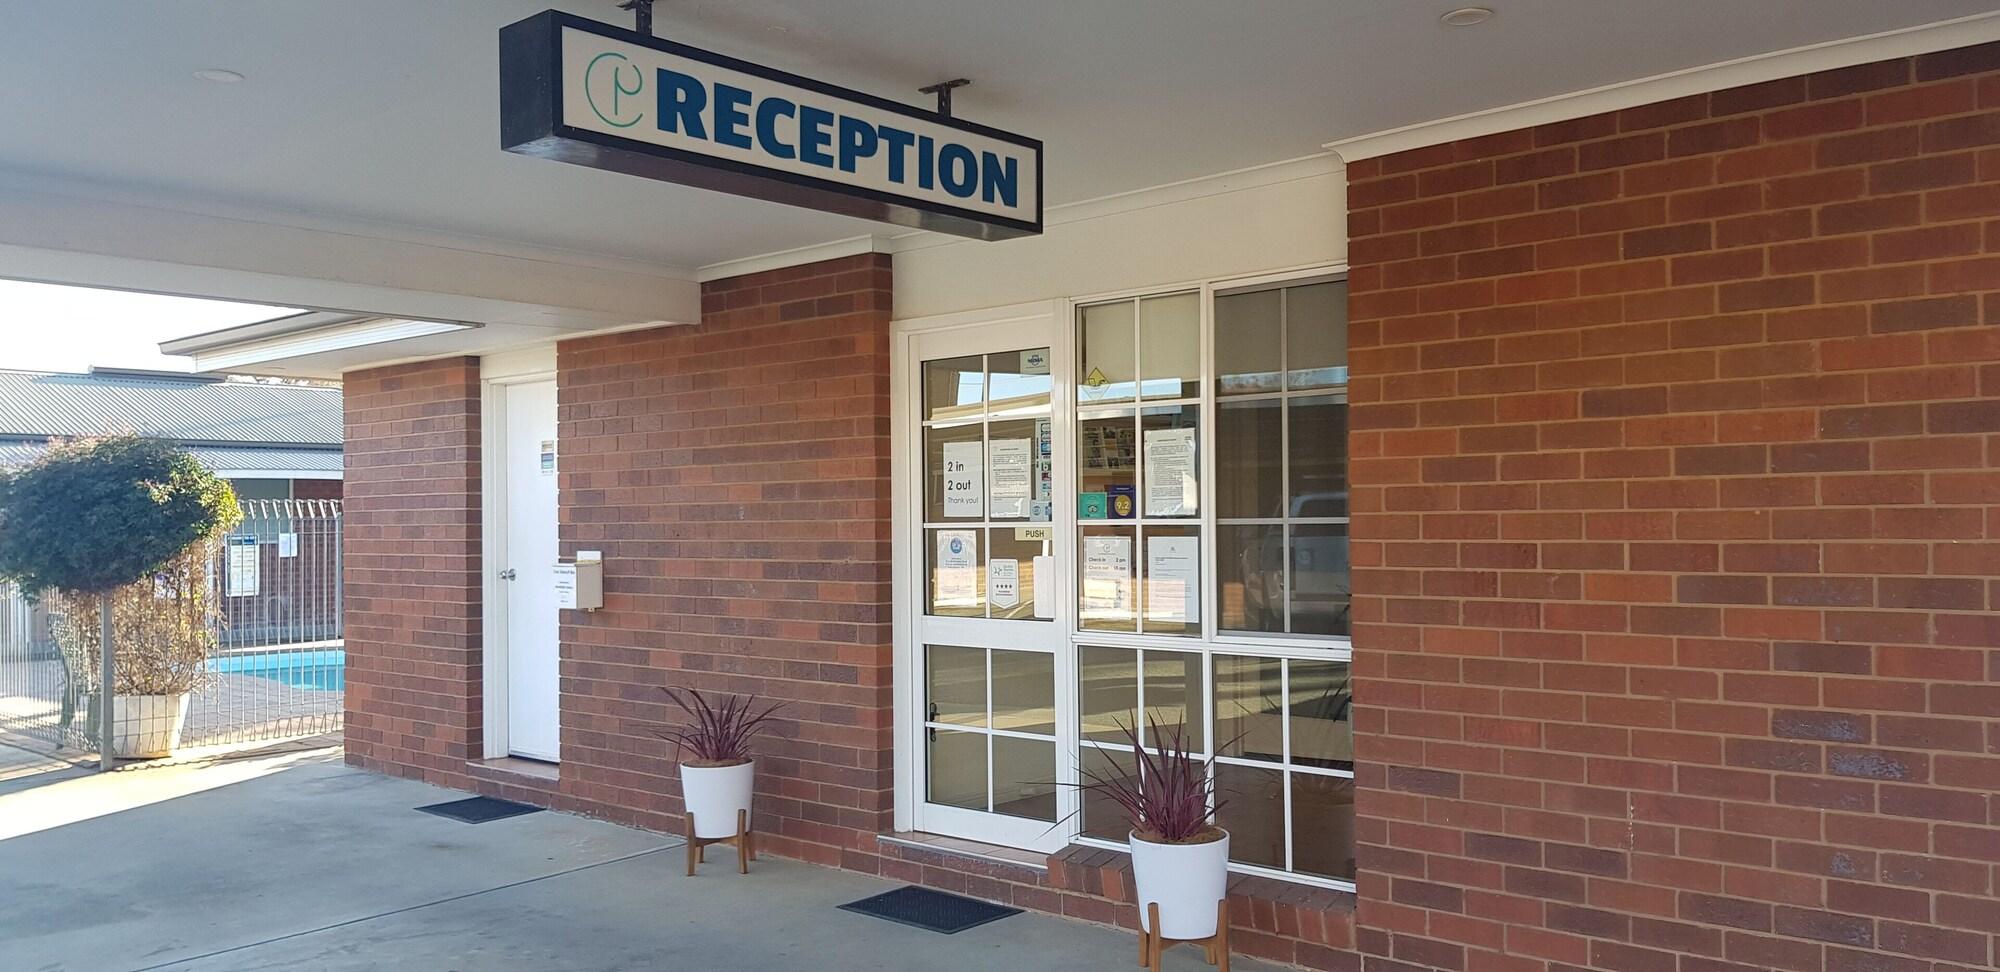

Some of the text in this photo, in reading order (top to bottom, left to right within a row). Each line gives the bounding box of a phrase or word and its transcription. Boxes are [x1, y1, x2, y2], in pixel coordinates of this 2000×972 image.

[655, 66, 1019, 209] RECEPTION
[947, 461, 964, 472] 2 in
[947, 479, 971, 491] 2 out
[1116, 501, 1130, 510] 9.2
[1025, 529, 1045, 538] PUSH
